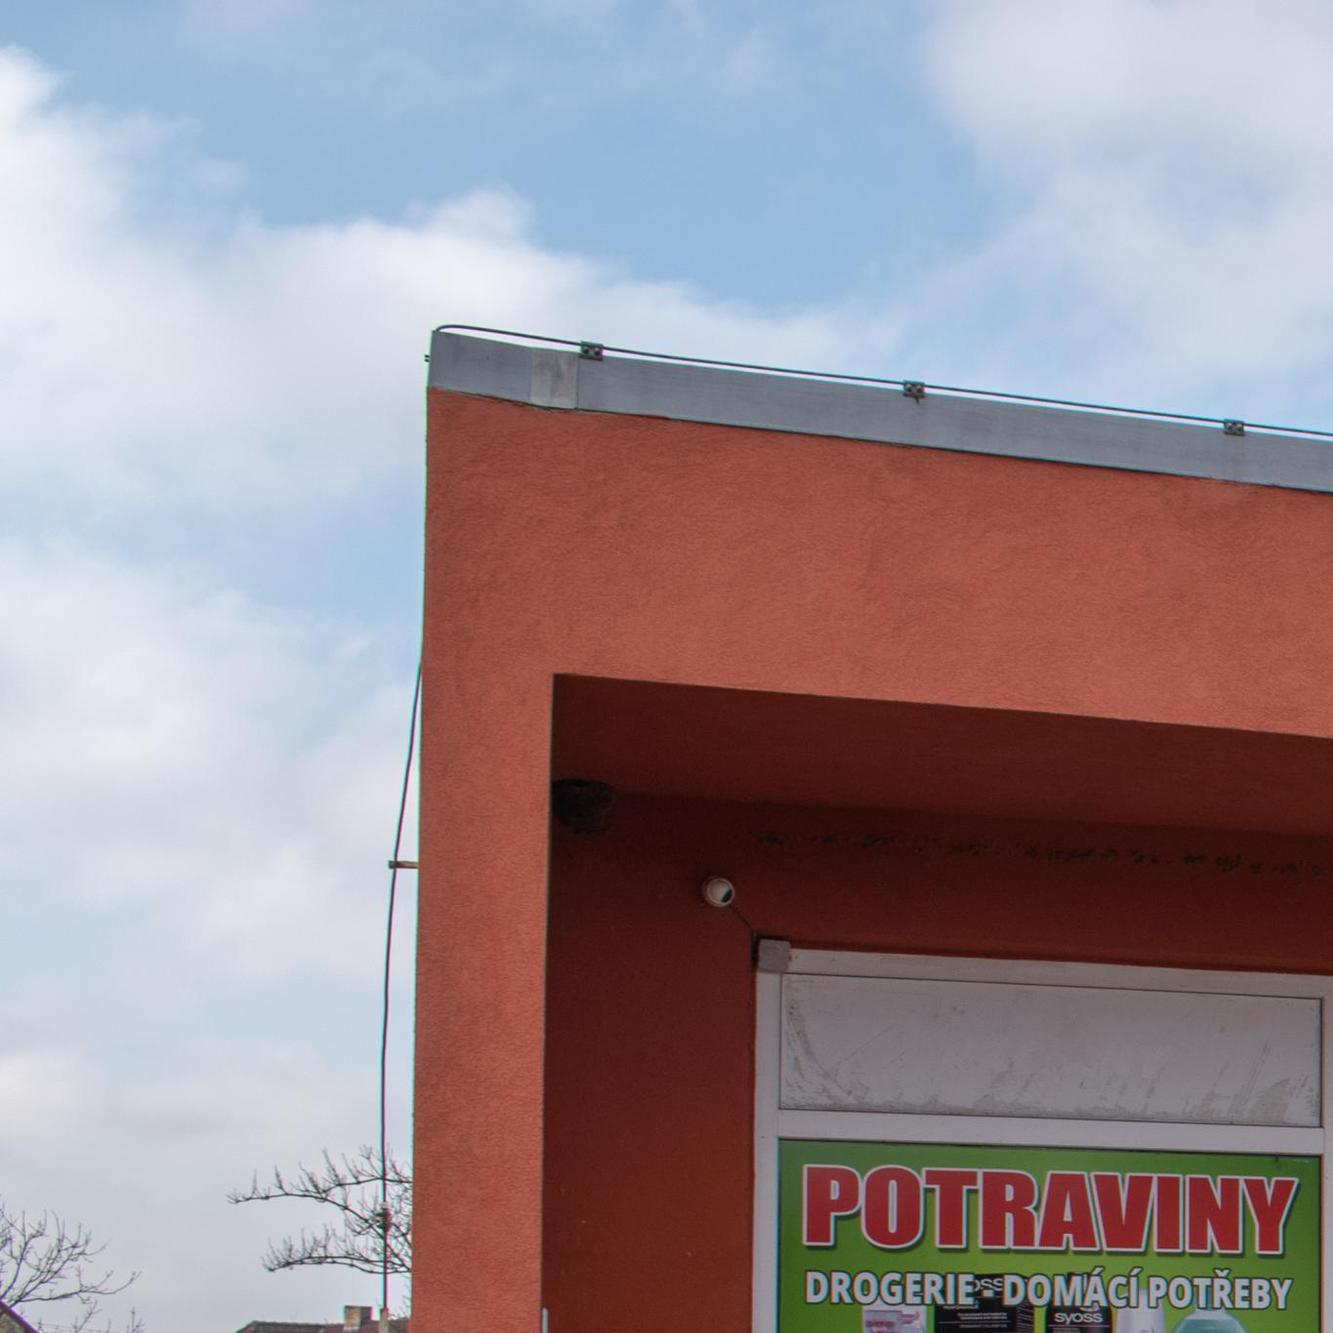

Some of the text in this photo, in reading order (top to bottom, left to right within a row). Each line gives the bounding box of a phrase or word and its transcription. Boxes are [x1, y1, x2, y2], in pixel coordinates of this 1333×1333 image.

[802, 1164, 1299, 1256] POTRAVINY
[805, 1270, 974, 1306] DROGERIE
[1002, 1265, 1141, 1309] DOMÁCÍ
[1148, 1268, 1294, 1311] POTŘEBY
[1053, 1311, 1104, 1326] syoss
